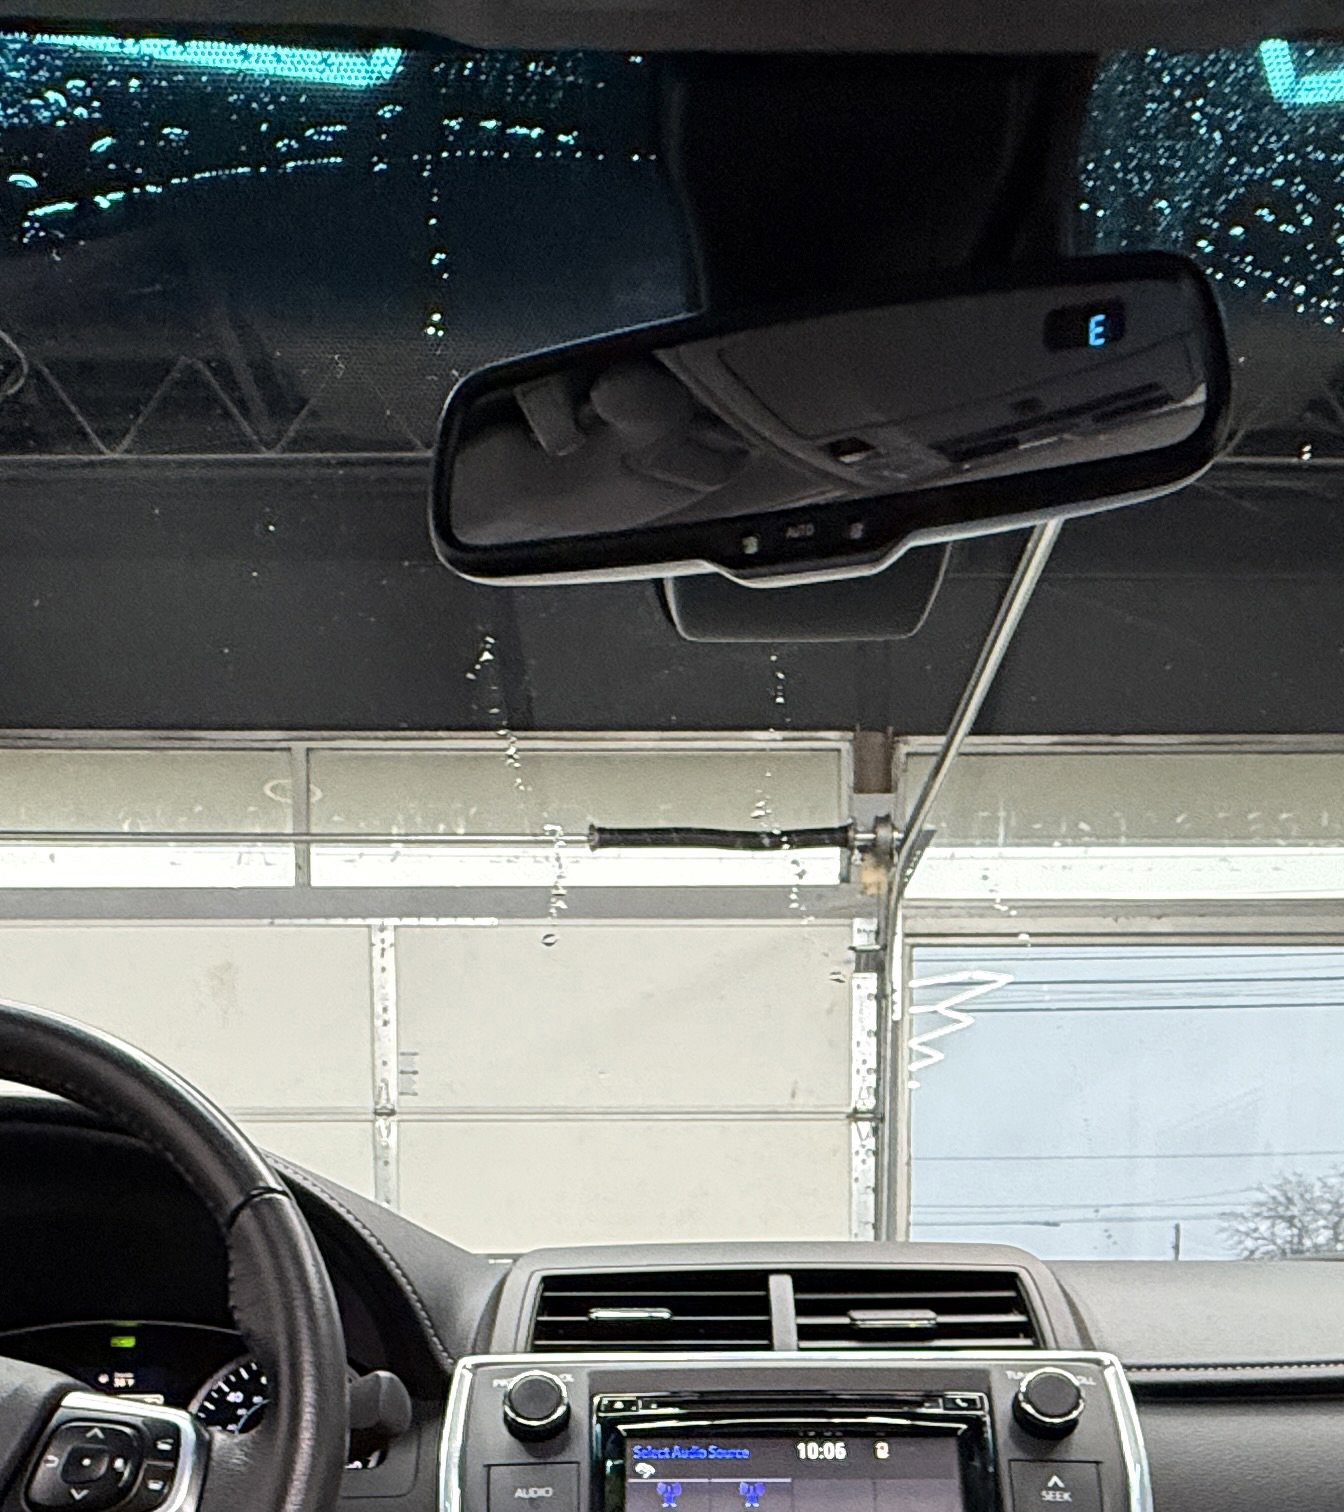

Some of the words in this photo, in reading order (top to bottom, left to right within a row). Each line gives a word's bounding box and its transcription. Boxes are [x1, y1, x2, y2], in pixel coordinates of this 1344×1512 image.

[1088, 313, 1106, 346] E
[672, 1445, 707, 1459] Audio
[514, 1486, 553, 1499] AUDIO
[1041, 1490, 1073, 1503] SEEK
